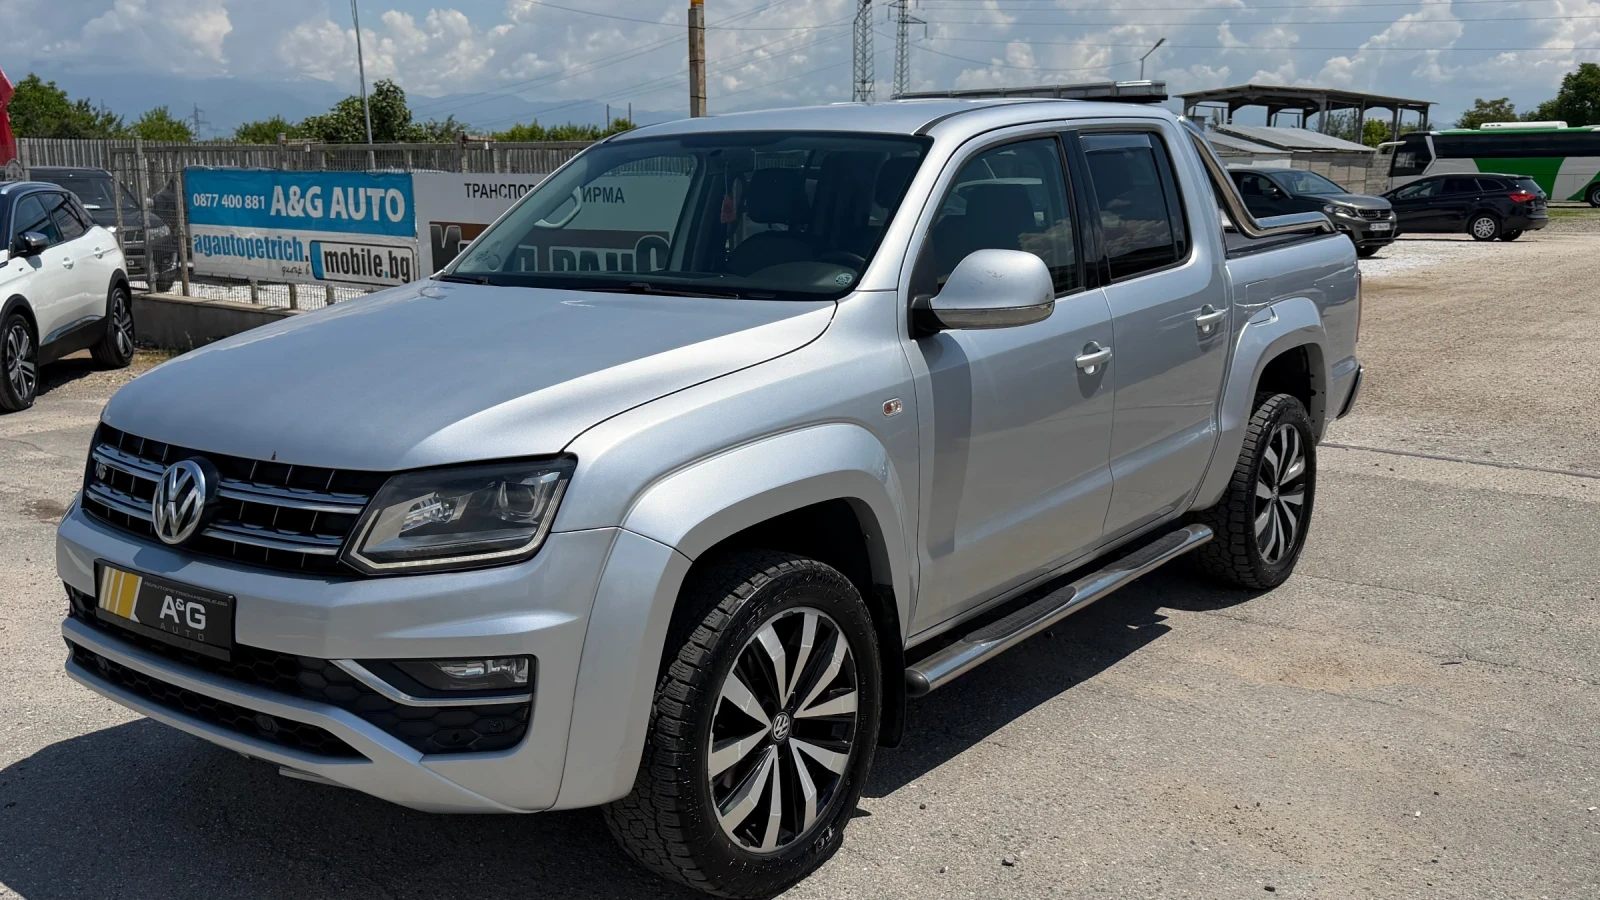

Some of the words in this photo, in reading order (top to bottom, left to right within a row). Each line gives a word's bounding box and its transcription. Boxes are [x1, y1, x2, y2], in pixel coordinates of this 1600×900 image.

[193, 192, 219, 208] 0877
[221, 194, 242, 209] 400
[244, 195, 265, 210] 881
[270, 185, 323, 218] A&G
[330, 186, 405, 223] AUTO
[582, 186, 625, 204] ИРМА
[324, 248, 410, 283] mobile.bg
[159, 594, 206, 630] A&G
[160, 622, 205, 641] AUTO
